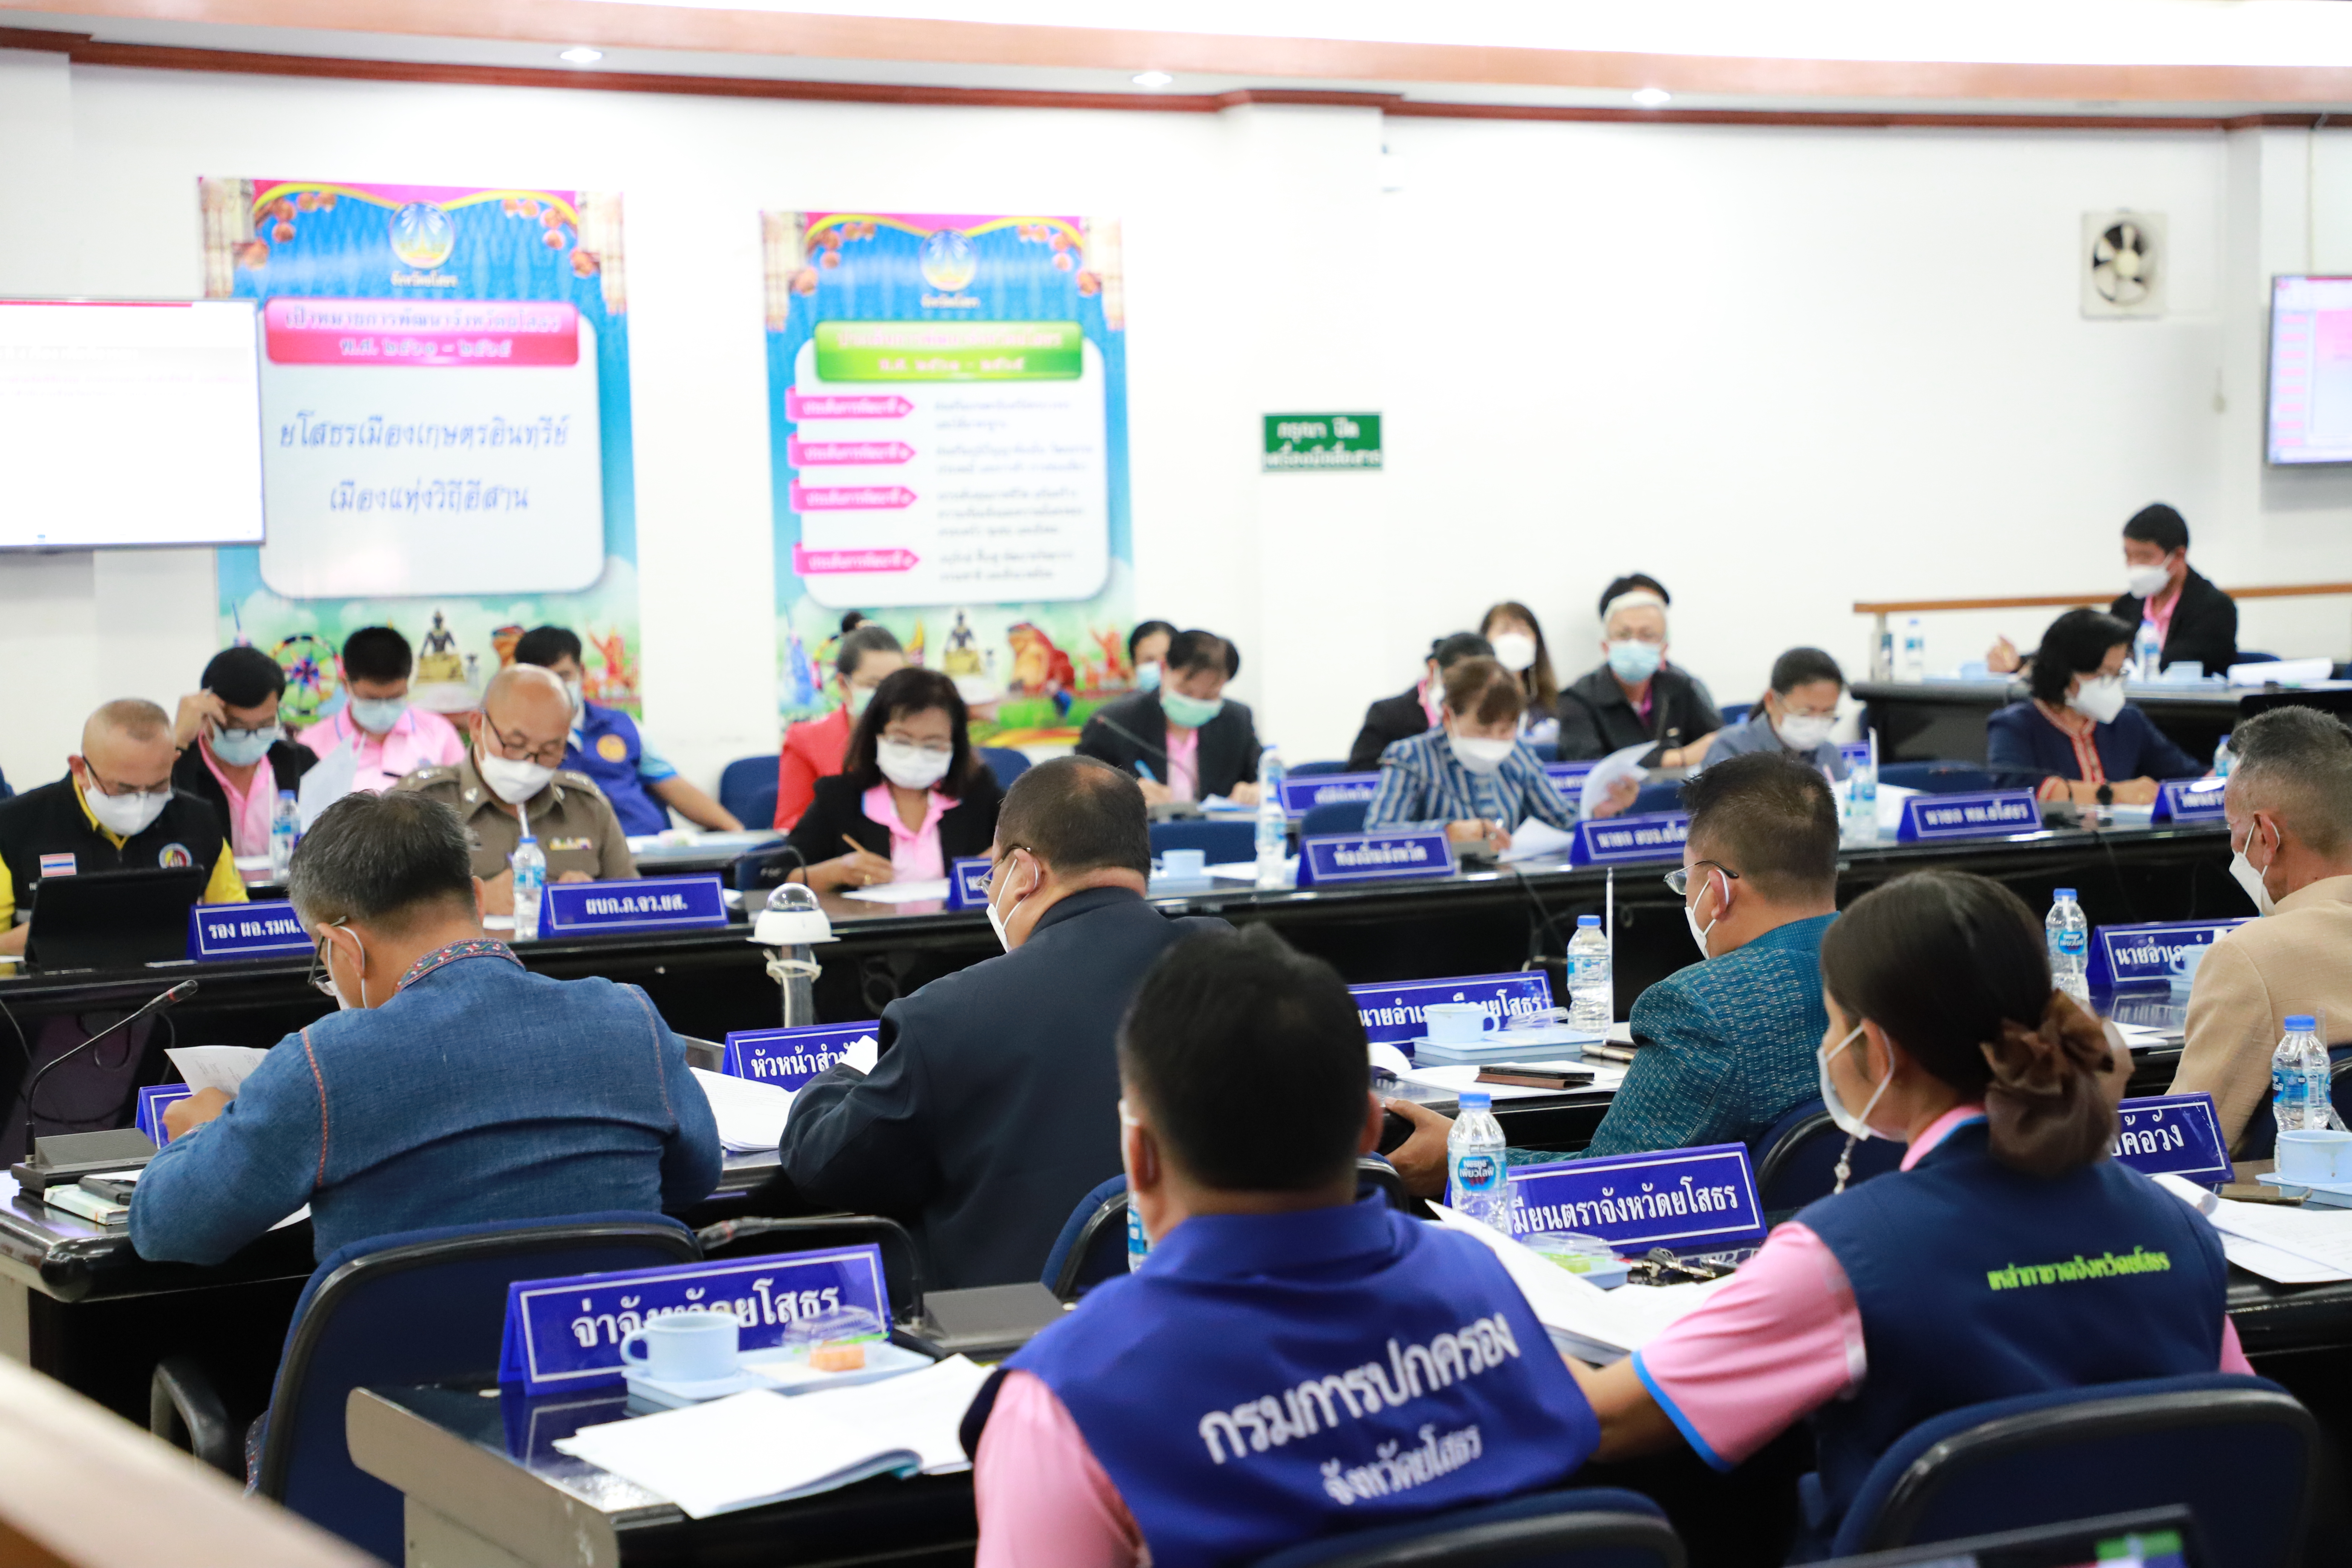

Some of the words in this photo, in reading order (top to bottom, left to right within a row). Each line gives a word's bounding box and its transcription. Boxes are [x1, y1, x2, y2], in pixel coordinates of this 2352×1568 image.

[280, 409, 570, 451] ยโสธรเมืองเกษตรอินทรีย์
[330, 476, 529, 516] เมืองแห่งวิถีอีสาน
[208, 923, 236, 940] รอง
[240, 919, 306, 938] ผอ.รมน.
[1506, 1175, 1739, 1235] มียนตราจังหวัดยโสธร
[1198, 1312, 1521, 1465] กรมการปกครอง
[1320, 1423, 1483, 1505] จังหวัดยโสธร
